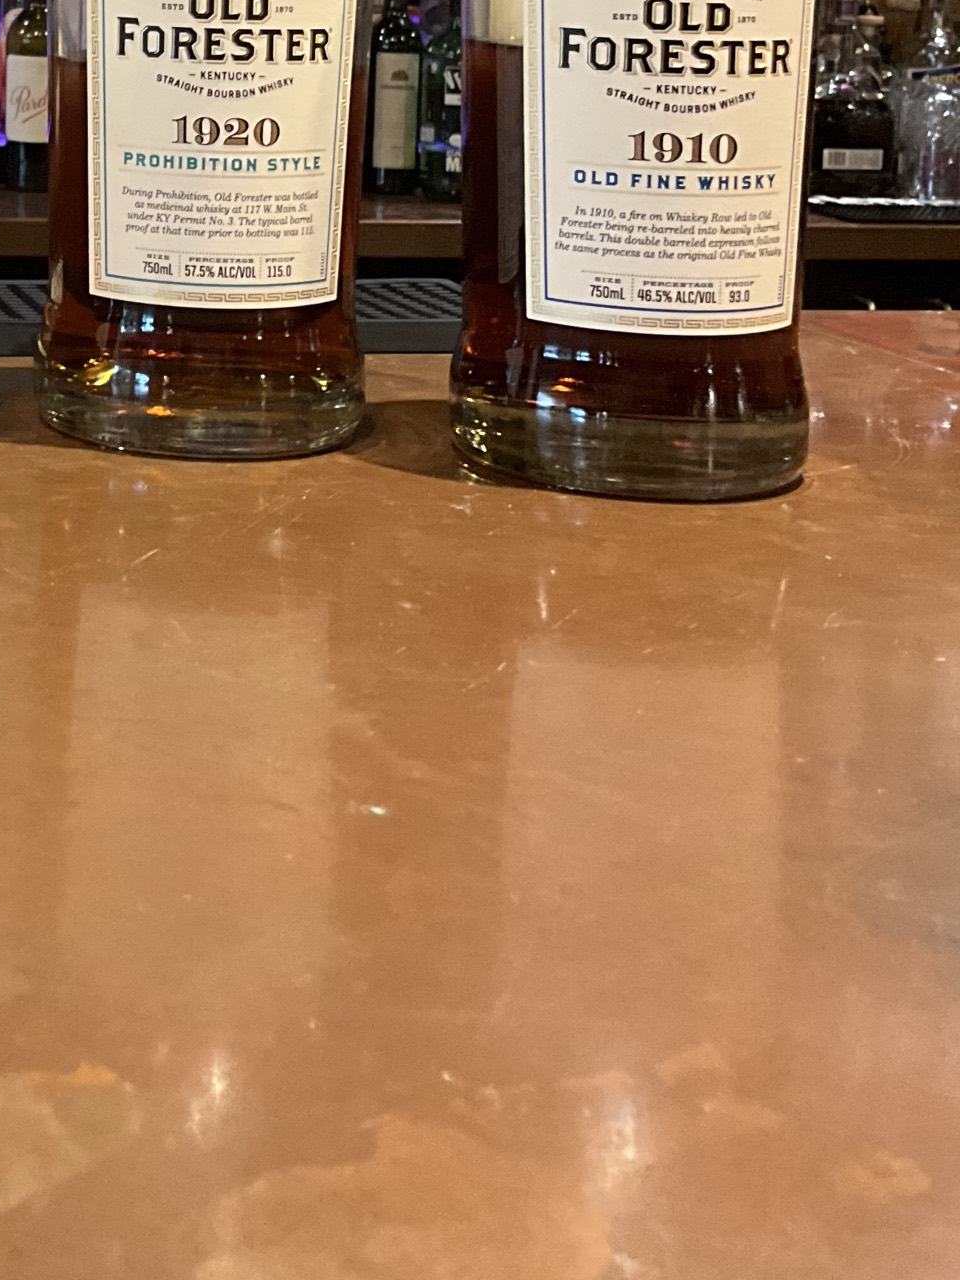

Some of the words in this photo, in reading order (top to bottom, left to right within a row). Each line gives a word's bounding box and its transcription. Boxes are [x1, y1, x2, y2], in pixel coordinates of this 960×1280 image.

[161, 3, 184, 11] ESTD
[612, 13, 639, 21] ESTD
[116, 16, 329, 62] FORESTER
[558, 26, 790, 75] FORESTER
[156, 73, 204, 95] STRAIGHT
[207, 87, 256, 99] BOURBON
[257, 76, 294, 94] WHISKY
[200, 71, 256, 81] KENTUCKY
[656, 85, 717, 95] KENTUCKY
[606, 87, 661, 110] STRAIGHT
[663, 101, 717, 114] BOURBON
[719, 91, 756, 110] WHISKY
[171, 115, 281, 147] 1920
[627, 130, 738, 164] 1910
[123, 151, 257, 172] PROHIBITION
[267, 156, 321, 171] STYLE
[574, 170, 618, 186] OLD
[630, 174, 686, 190] FINE
[698, 174, 776, 190] WHISKY
[122, 186, 153, 200] During
[155, 188, 212, 202] Prohibition,
[214, 192, 231, 202] Old
[234, 192, 273, 202] Forester
[292, 190, 319, 201] bottled
[575, 206, 586, 216] In
[590, 207, 616, 219] 1910,
[627, 210, 646, 221] fire
[666, 212, 708, 224] Whiskey
[711, 213, 731, 222] Row
[734, 212, 746, 221] led
[749, 213, 757, 221] to
[142, 261, 174, 276] 750mL
[184, 264, 215, 278] 57.5%
[217, 265, 256, 279] ALC/VOL
[267, 264, 292, 278] 115.0
[590, 284, 625, 300] 750mL
[637, 288, 672, 303] 46.5%
[675, 289, 716, 304] ALC/VOL
[729, 290, 750, 303] 93.0
